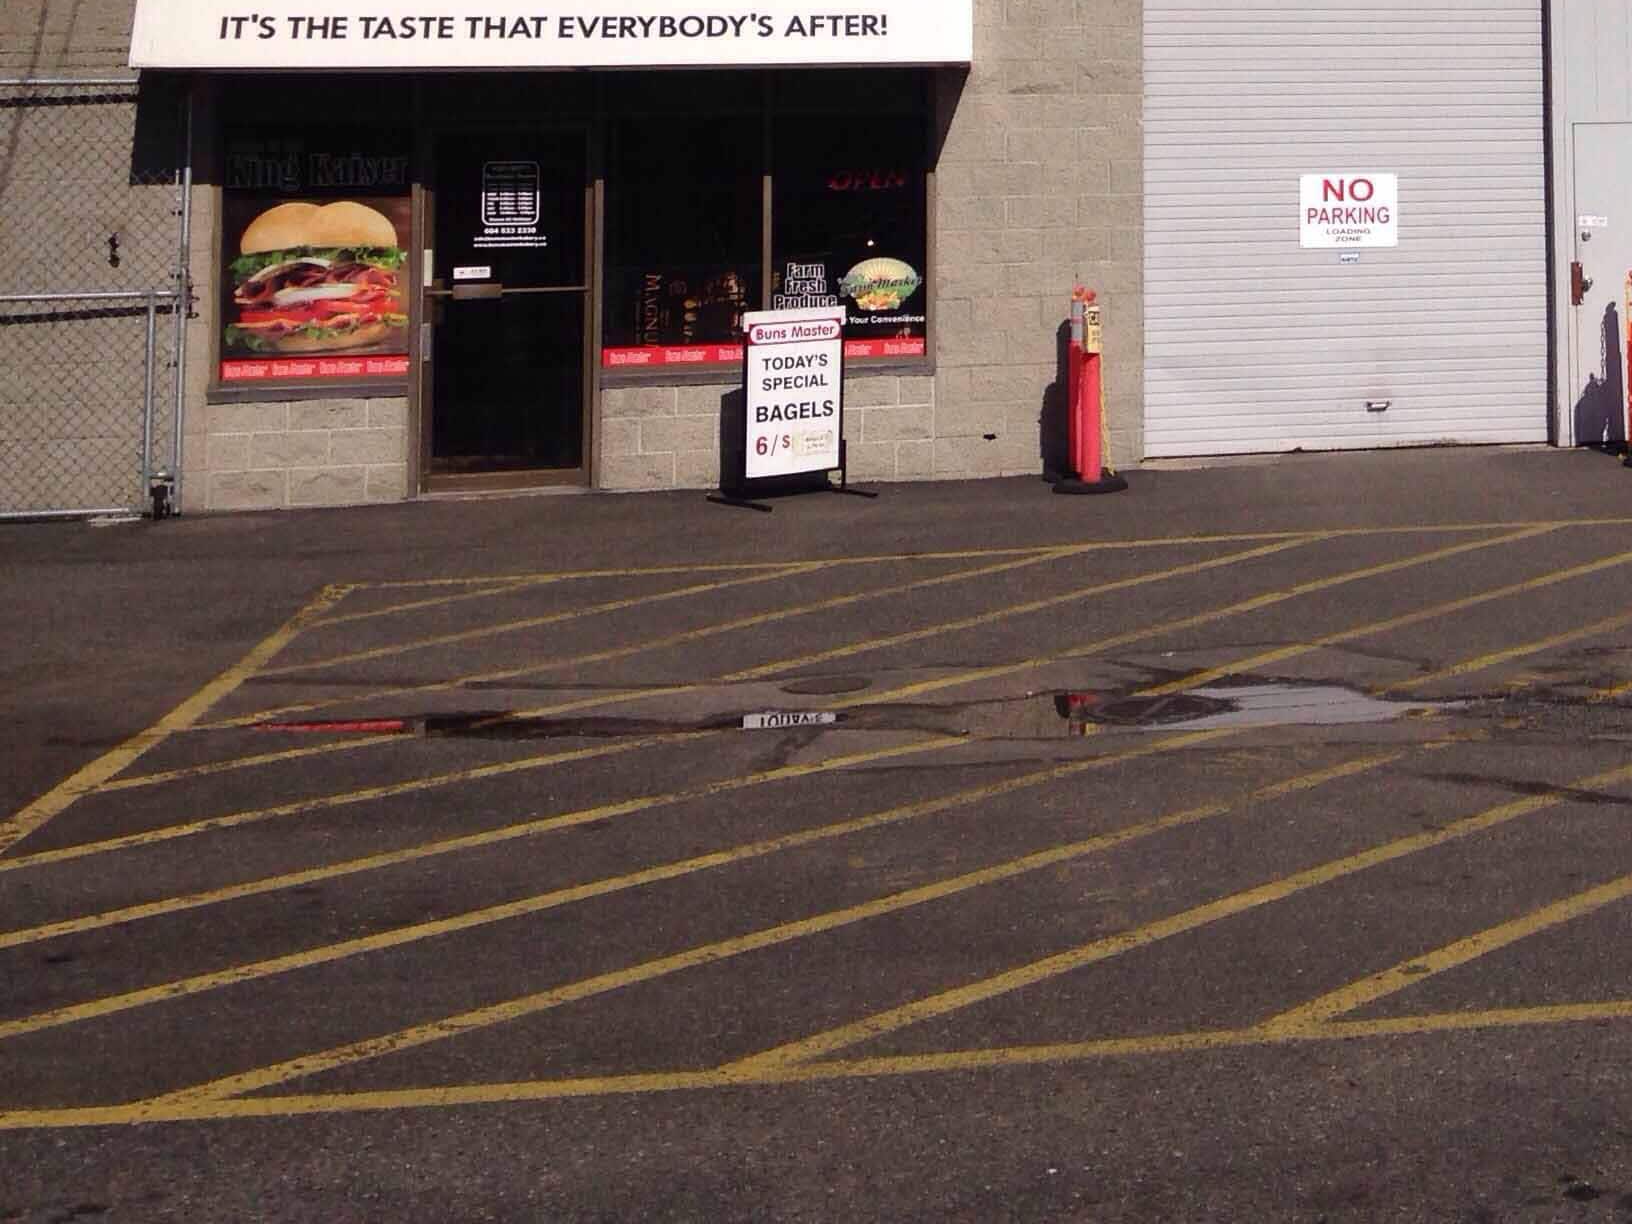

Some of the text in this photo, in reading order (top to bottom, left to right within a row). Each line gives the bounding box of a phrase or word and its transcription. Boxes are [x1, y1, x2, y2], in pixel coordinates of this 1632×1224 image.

[219, 13, 888, 40] IT'S THE TASTE THAT EVERYBODY'S AFTER!
[1322, 178, 1375, 203] NO
[1307, 206, 1391, 225] PARKING
[787, 262, 825, 280] Farm
[784, 277, 827, 294] Fresh
[755, 325, 835, 341] Buns Master
[762, 353, 829, 371] TODAY'S
[762, 373, 829, 391] SPECIAL
[755, 400, 834, 424] BAGELS
